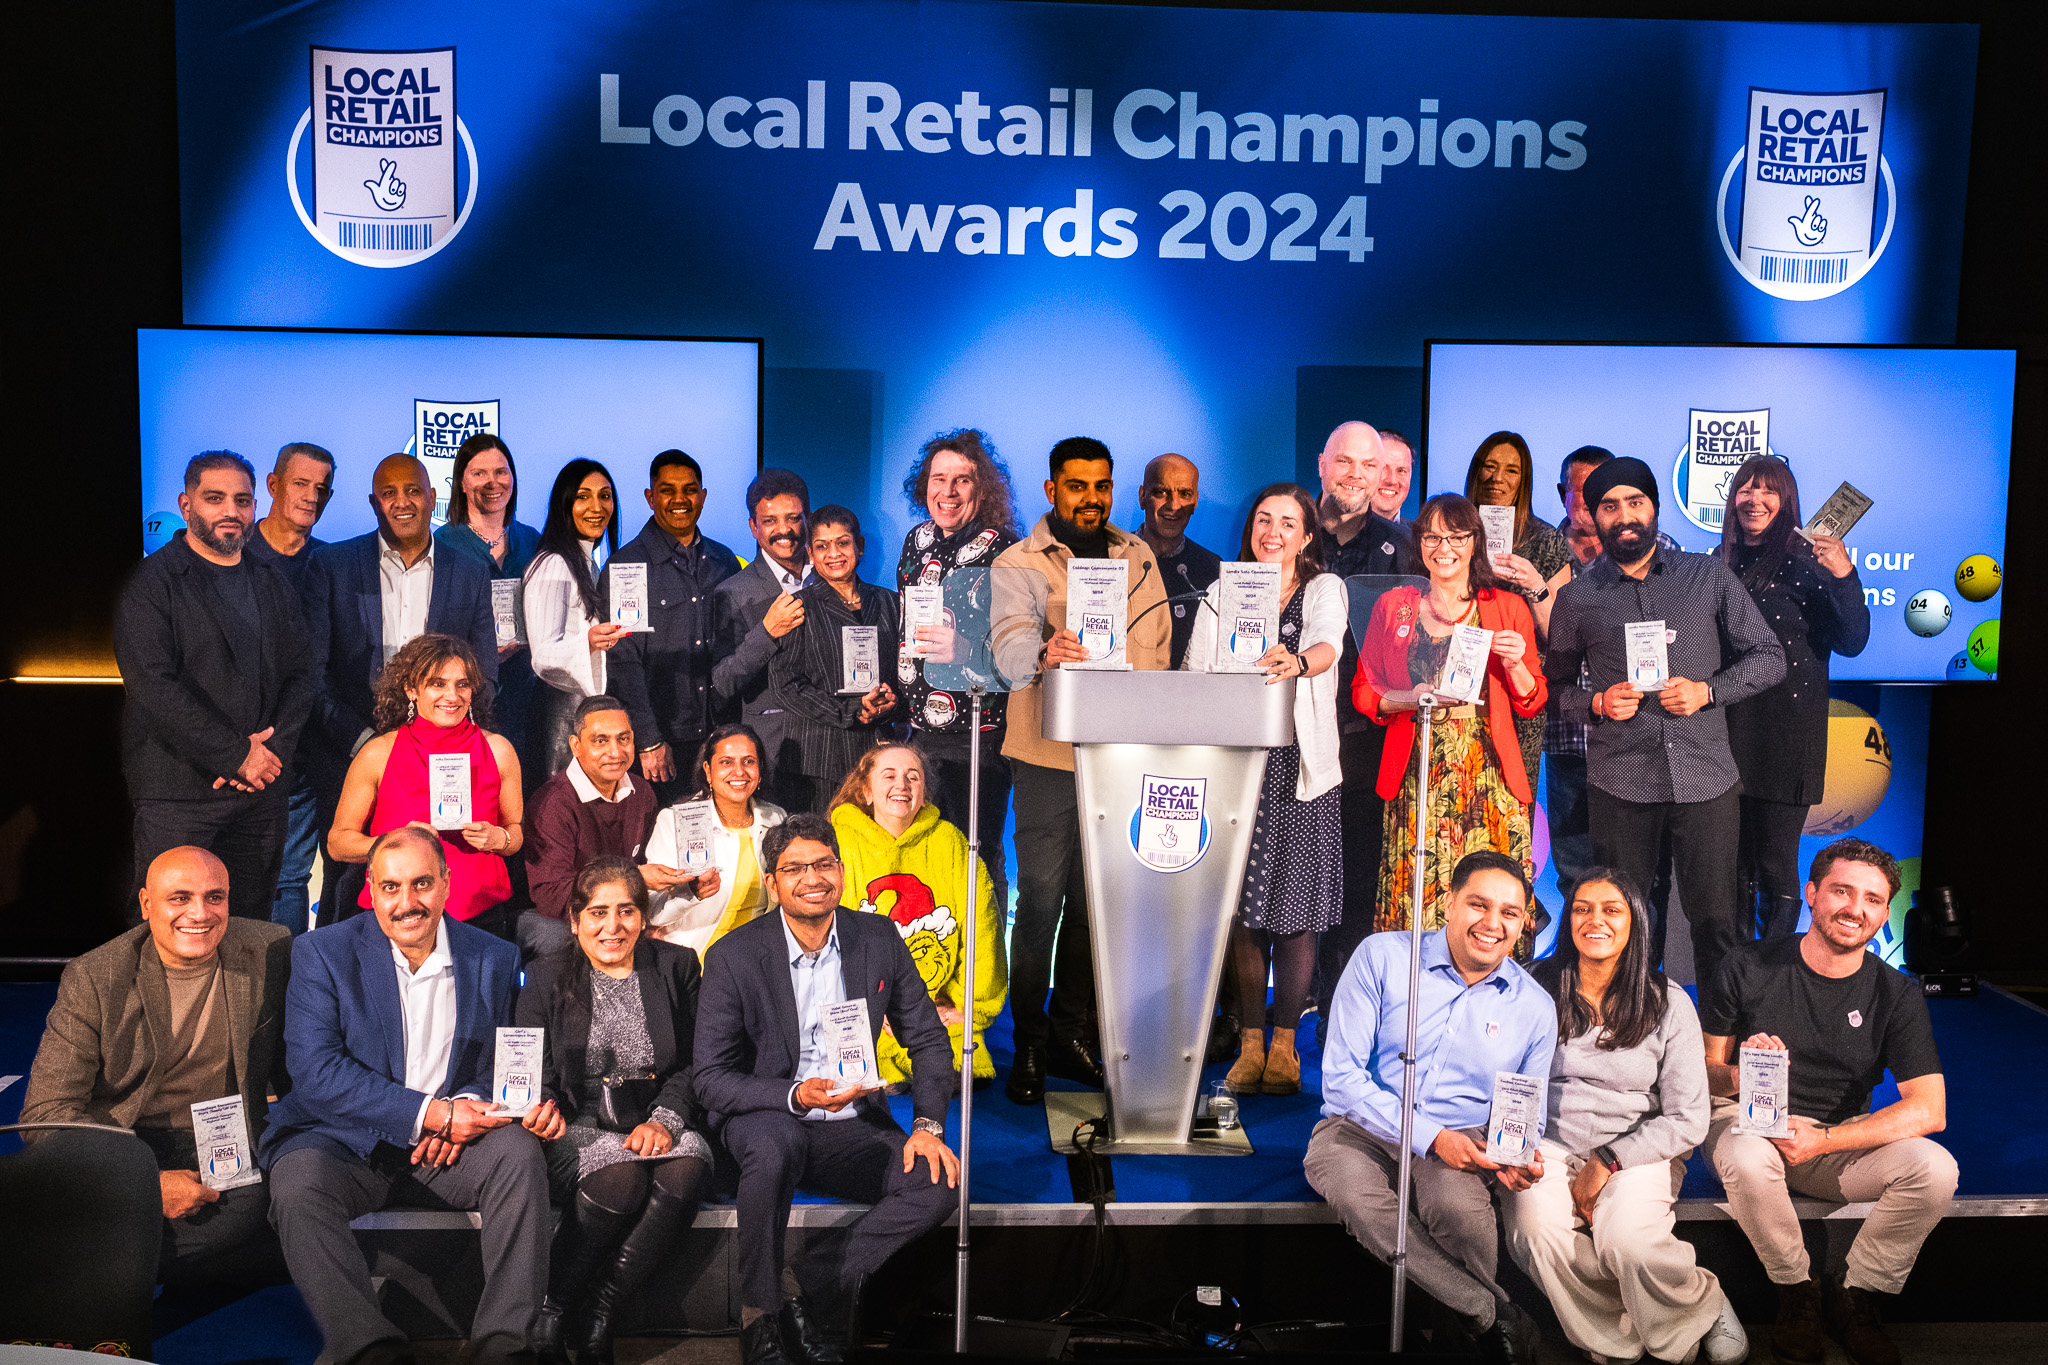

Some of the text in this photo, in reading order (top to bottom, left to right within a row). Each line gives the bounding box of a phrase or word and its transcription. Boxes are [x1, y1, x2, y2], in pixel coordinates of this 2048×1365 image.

[325, 64, 440, 96] LOCAL
[326, 94, 442, 124] RETAIL
[600, 74, 1588, 184] Local Retail Champions
[1760, 105, 1869, 136] LOCAL
[329, 126, 440, 146] CHAMPIONS
[1758, 132, 1868, 164] RETAIL
[1760, 165, 1862, 183] CHAMPIONS
[813, 182, 1374, 262] Awards 2024
[424, 410, 490, 428] LOCAL
[1697, 420, 1760, 436] LOCAL
[1696, 436, 1760, 452] RETAIL
[148, 521, 162, 532] 17
[1865, 552, 1914, 570] our
[1959, 566, 1974, 580] 48
[1910, 599, 1927, 610] 04
[1970, 637, 1984, 657] 37
[1954, 658, 1967, 669] 13
[1149, 783, 1199, 797] LOCAL
[1148, 795, 1198, 810] RETAIL
[1146, 809, 1198, 819] CHAMPIONS
